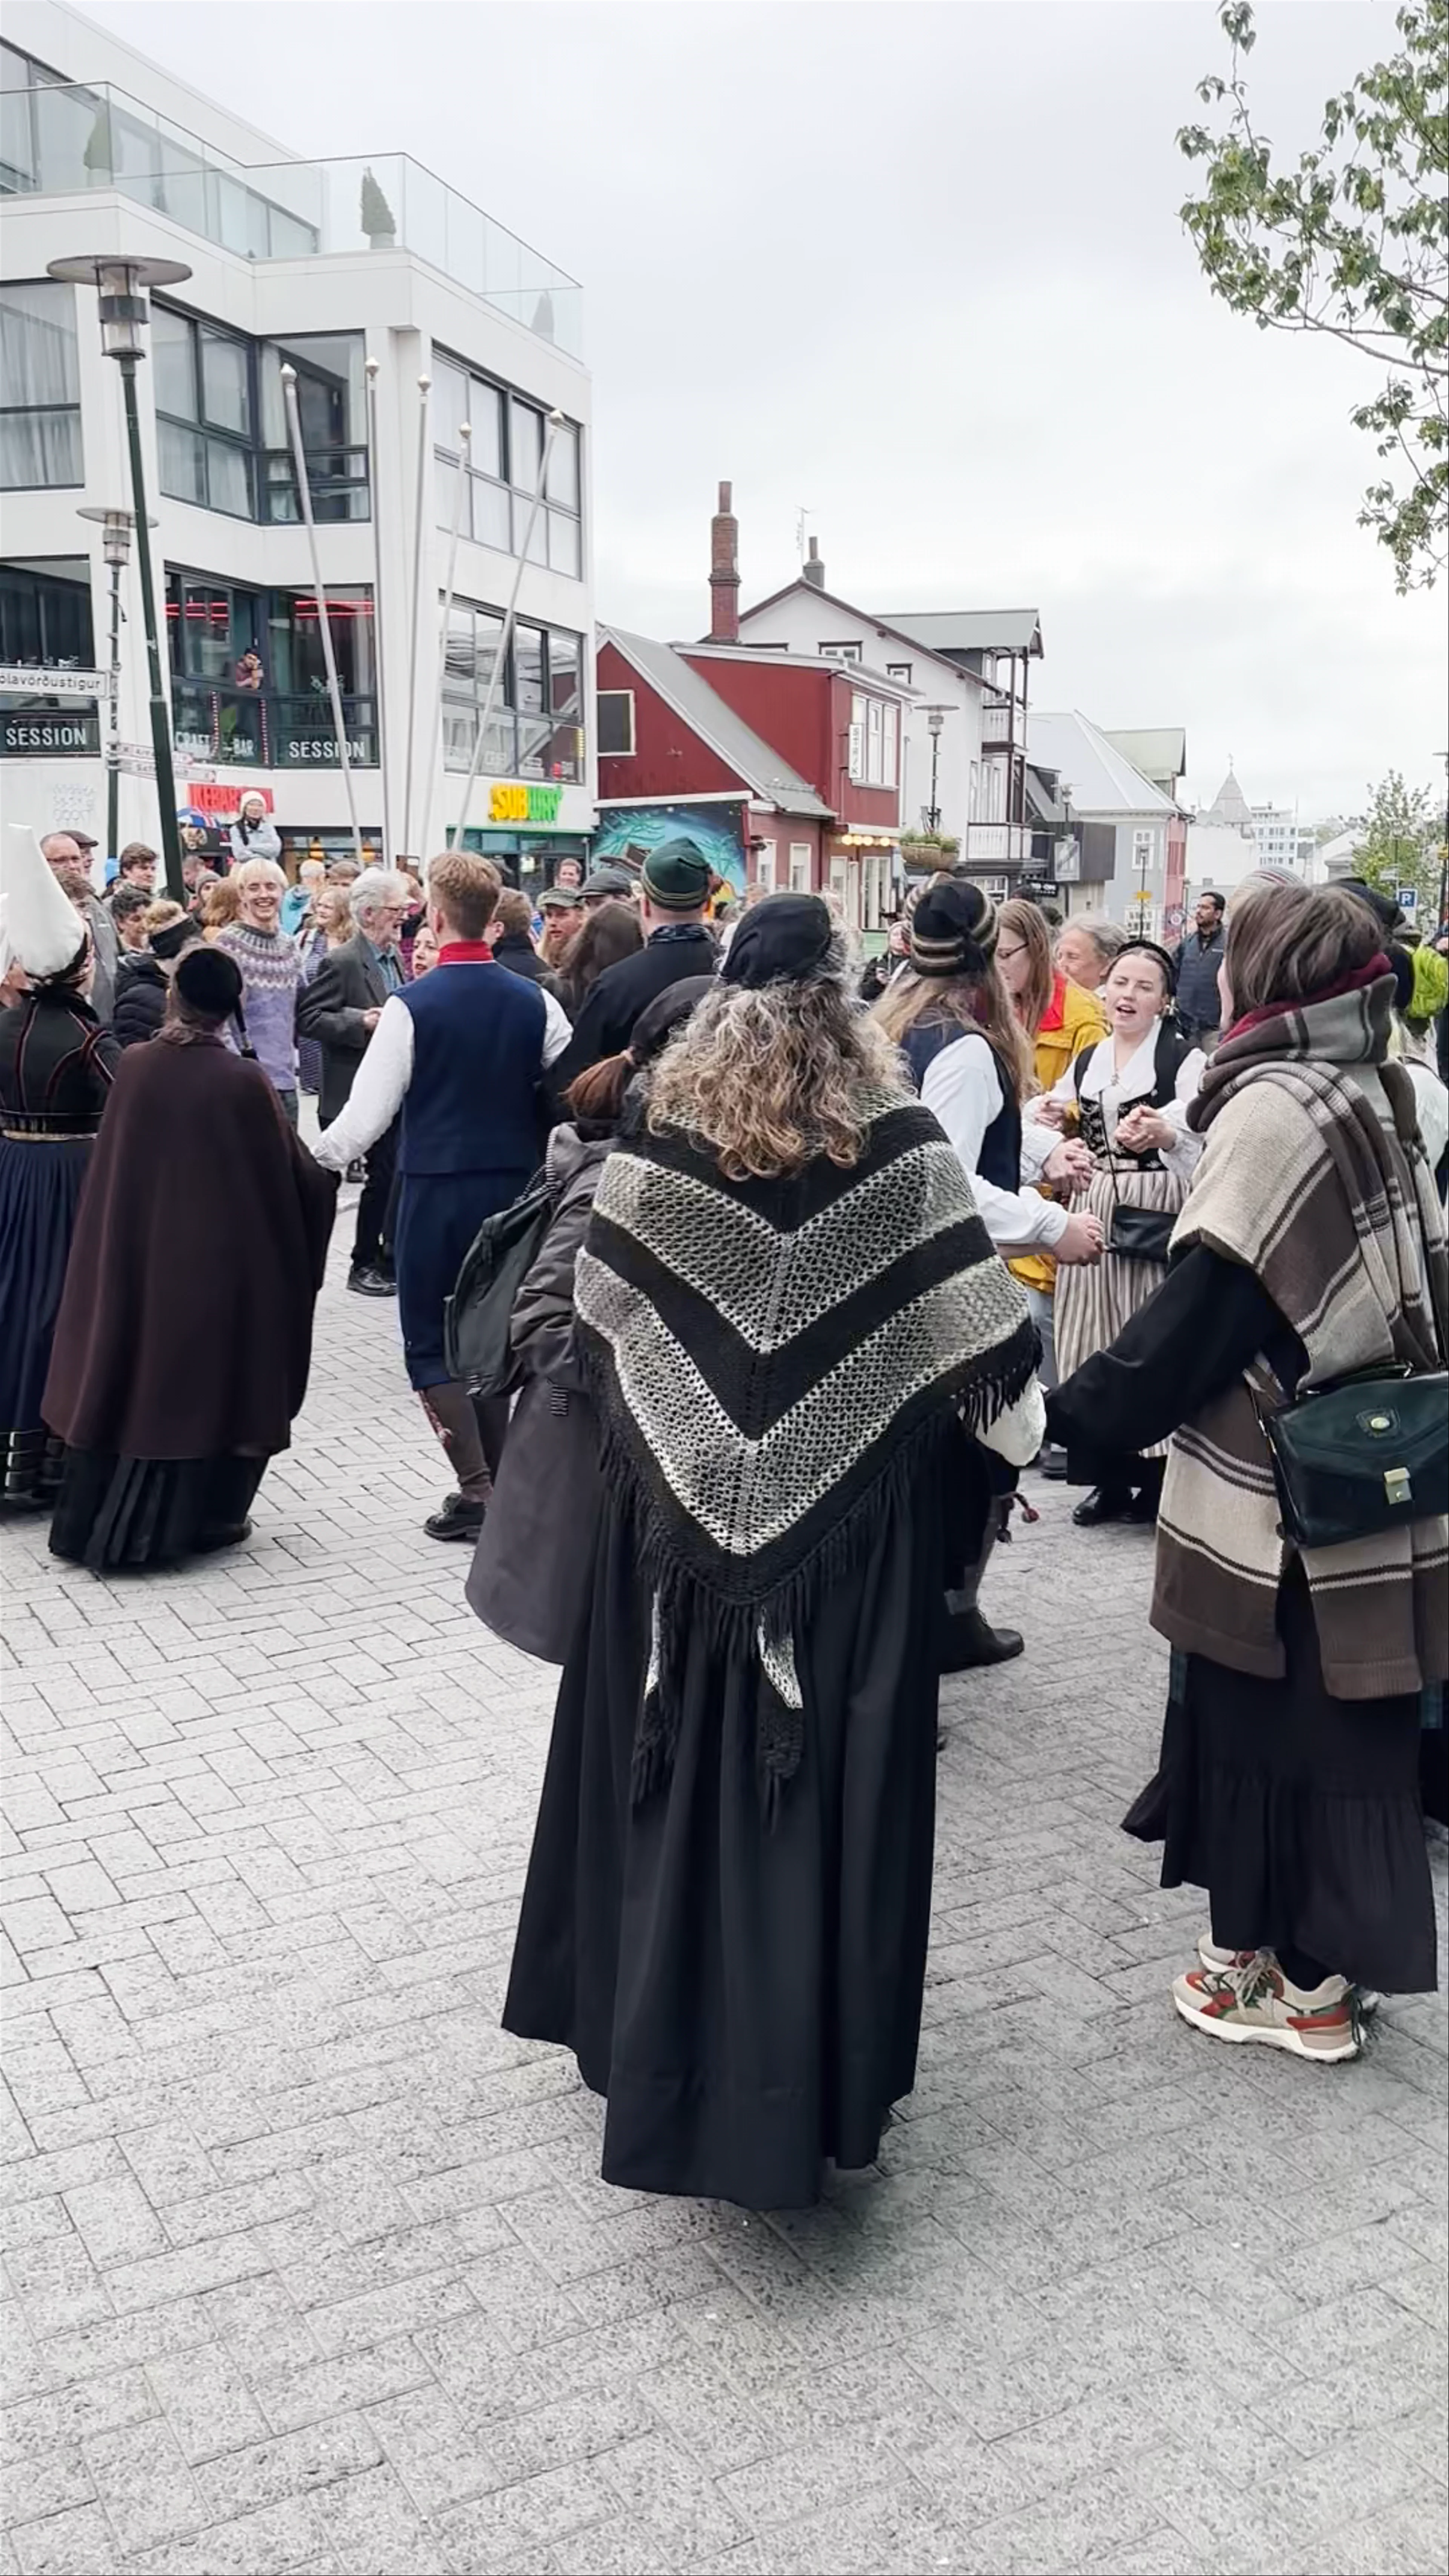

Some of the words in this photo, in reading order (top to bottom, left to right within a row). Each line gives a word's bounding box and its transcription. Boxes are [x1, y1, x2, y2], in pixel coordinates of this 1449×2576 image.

[6, 727, 86, 746] SESSION
[289, 741, 365, 758] SESSION
[489, 785, 563, 821] SUBWAY
